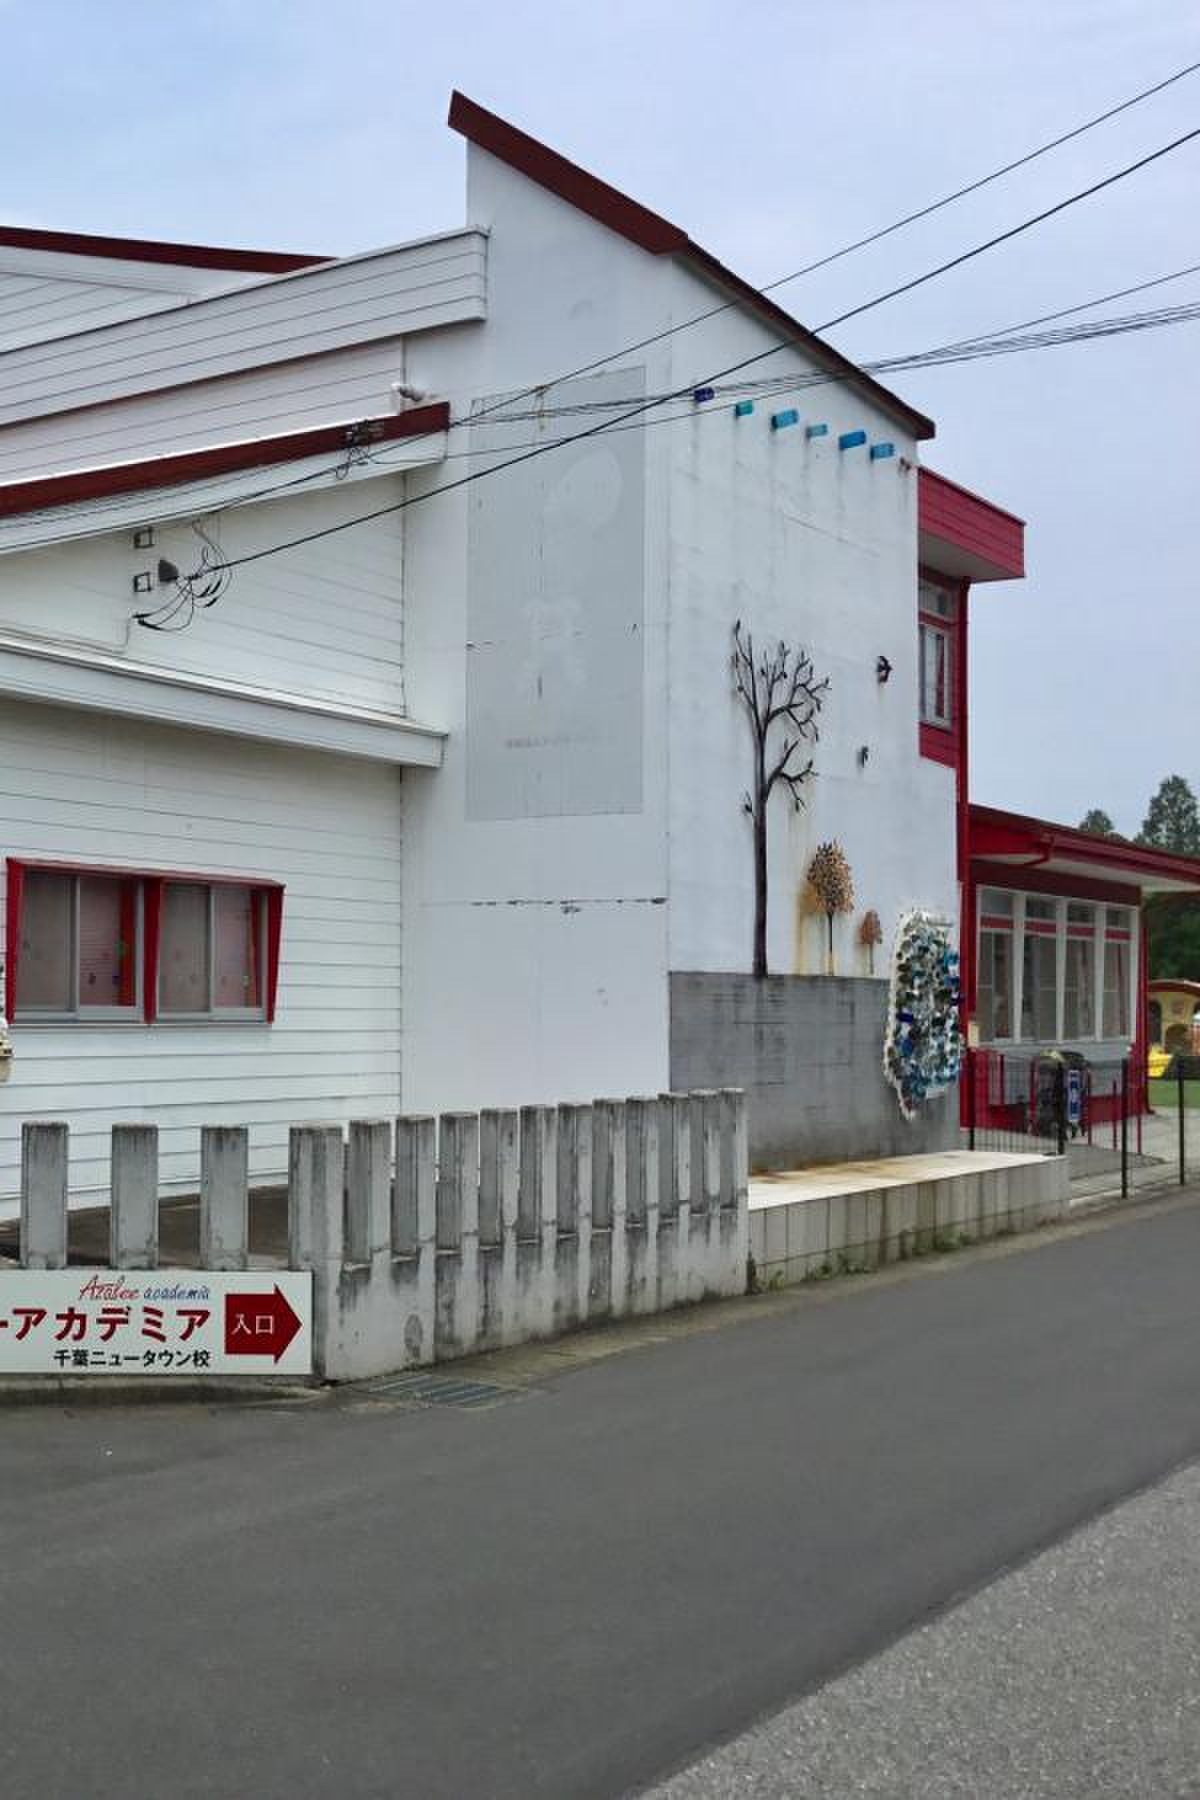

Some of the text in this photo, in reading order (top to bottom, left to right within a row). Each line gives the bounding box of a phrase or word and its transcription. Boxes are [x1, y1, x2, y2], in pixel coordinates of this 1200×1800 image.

[143, 1283, 209, 1300] academia
[231, 1313, 273, 1335] 入口
[53, 1349, 210, 1367] 千葉ニュータウン校
